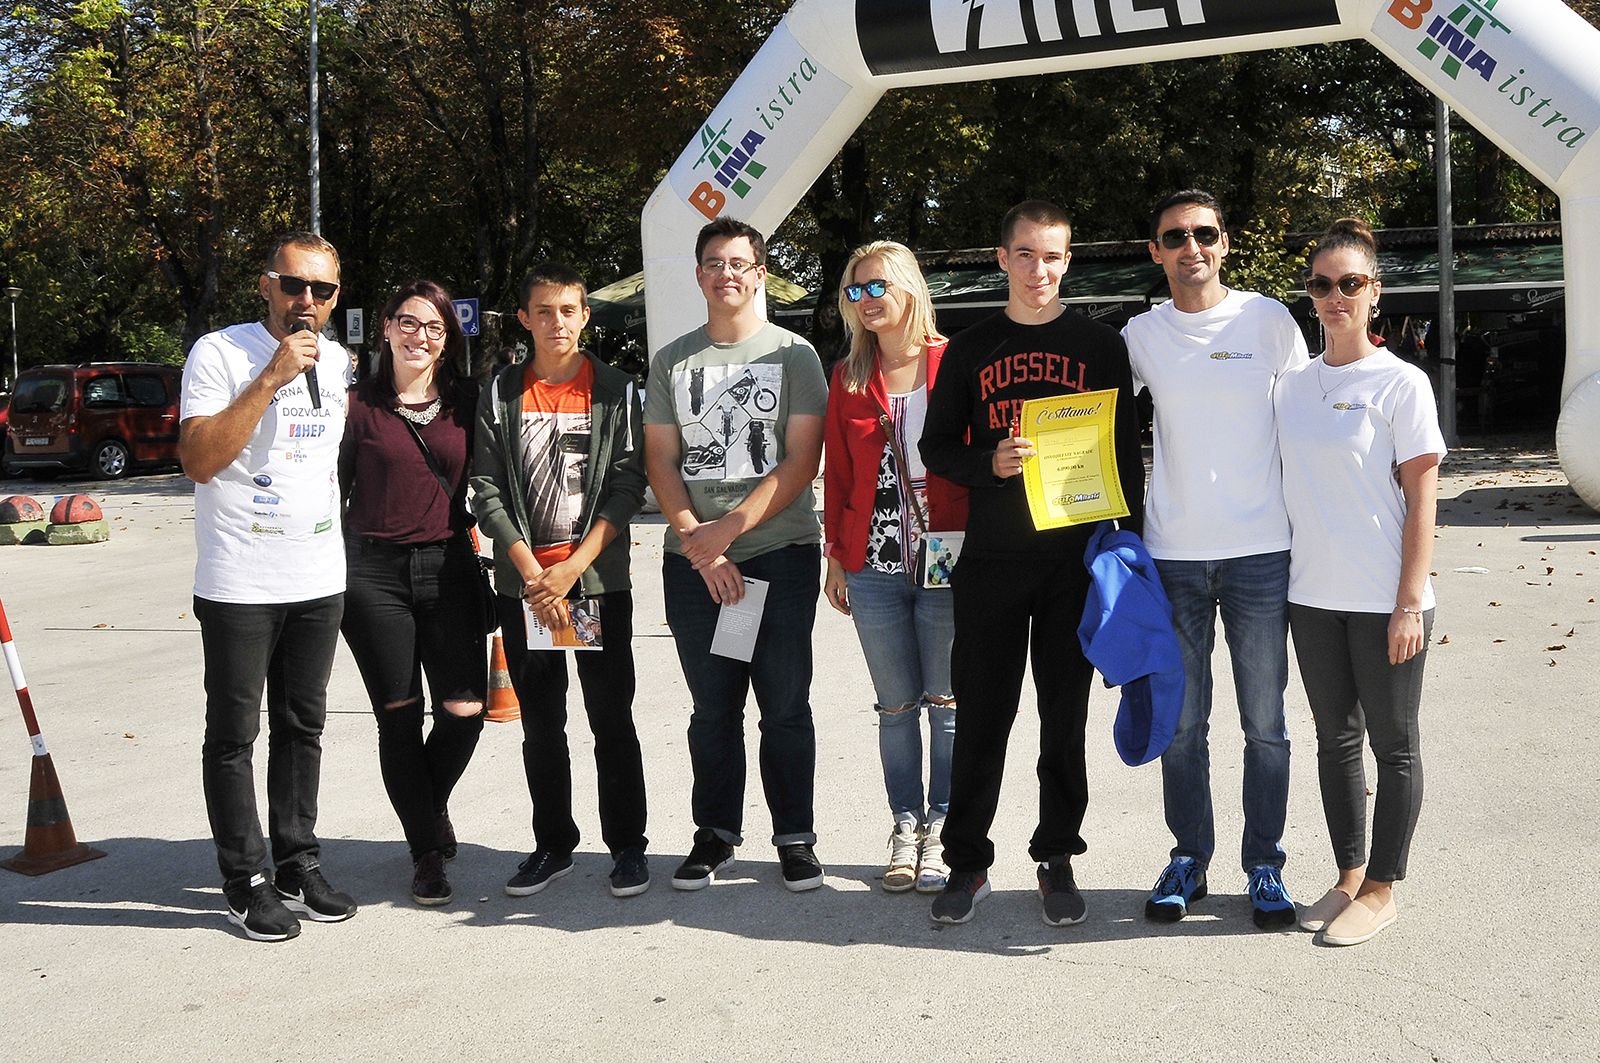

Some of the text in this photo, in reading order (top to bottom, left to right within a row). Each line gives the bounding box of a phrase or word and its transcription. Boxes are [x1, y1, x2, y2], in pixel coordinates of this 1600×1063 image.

[1387, 0, 1586, 148] BINA istra
[688, 57, 817, 221] BINA istra
[456, 303, 473, 323] P
[980, 352, 1091, 400] RUSSELL
[270, 386, 304, 405] URNA
[282, 407, 331, 418] DOZVOLA
[302, 424, 326, 438] HEP
